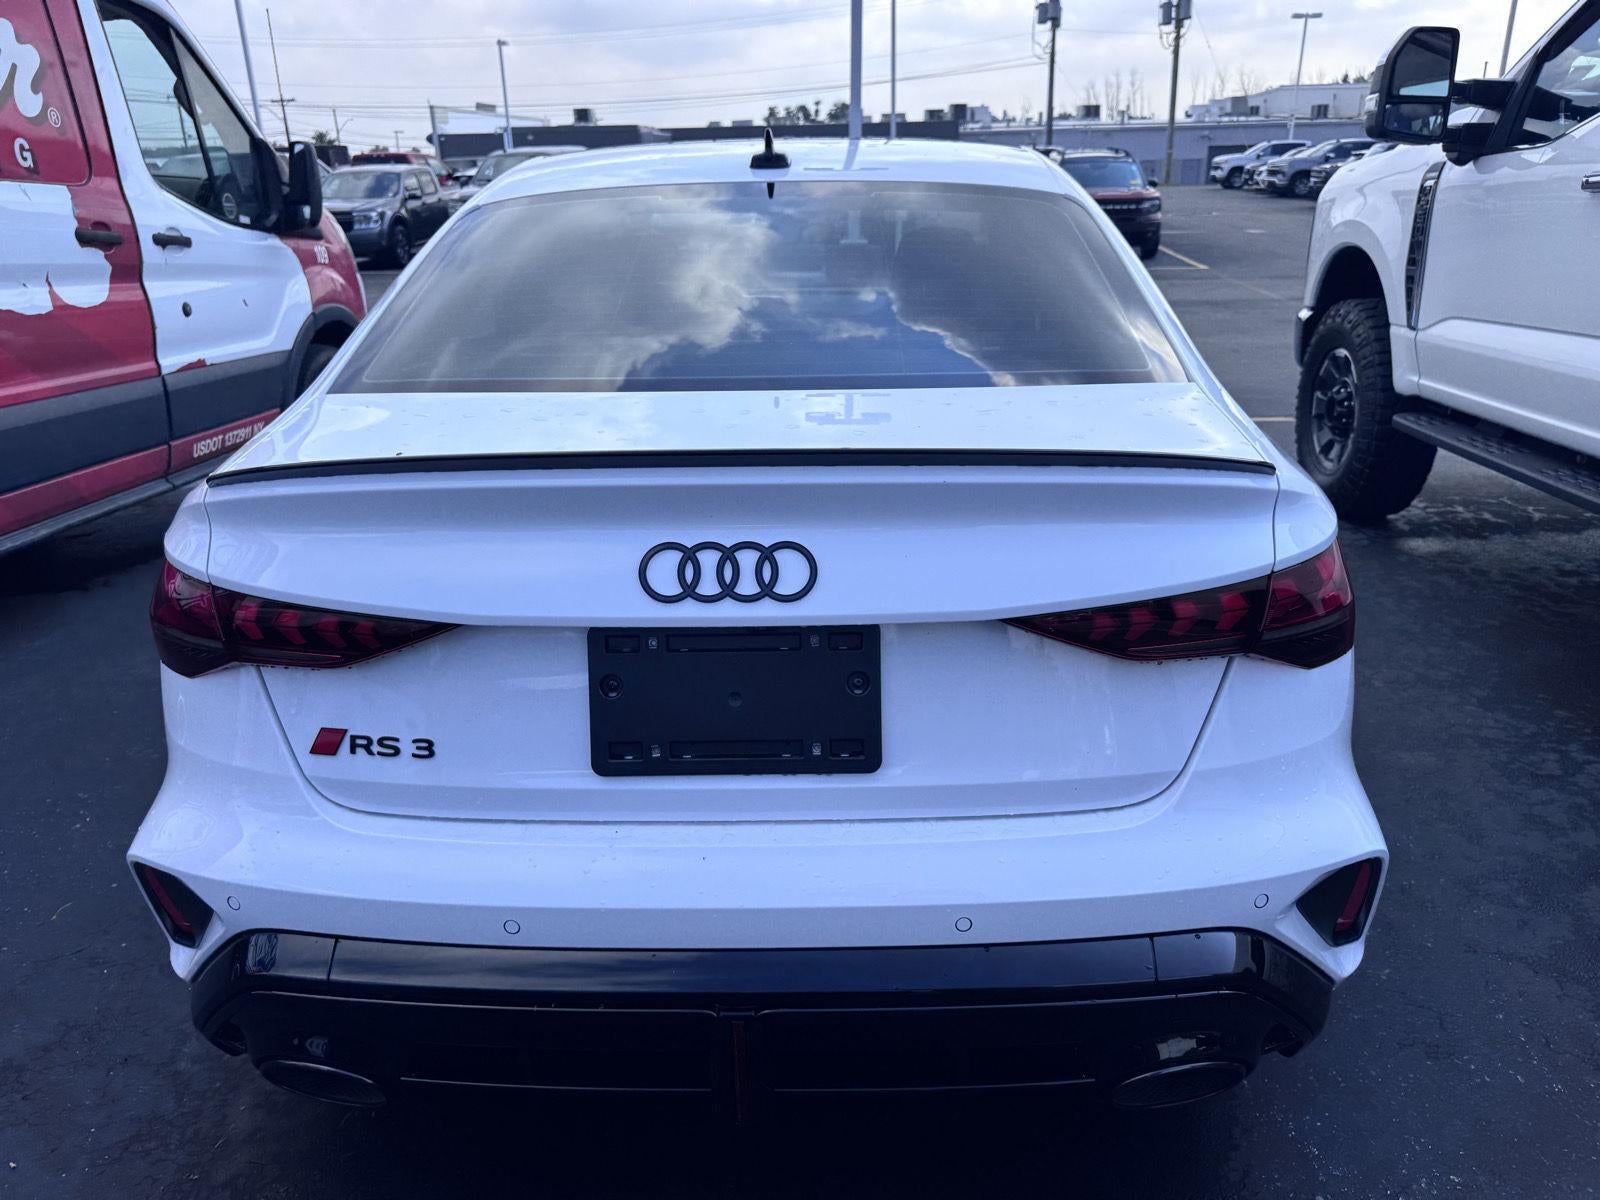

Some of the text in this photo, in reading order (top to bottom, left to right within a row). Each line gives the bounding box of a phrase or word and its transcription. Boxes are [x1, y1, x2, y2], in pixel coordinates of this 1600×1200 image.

[14, 137, 34, 168] G
[193, 435, 223, 458] USDOT
[350, 734, 436, 759] RS 3
